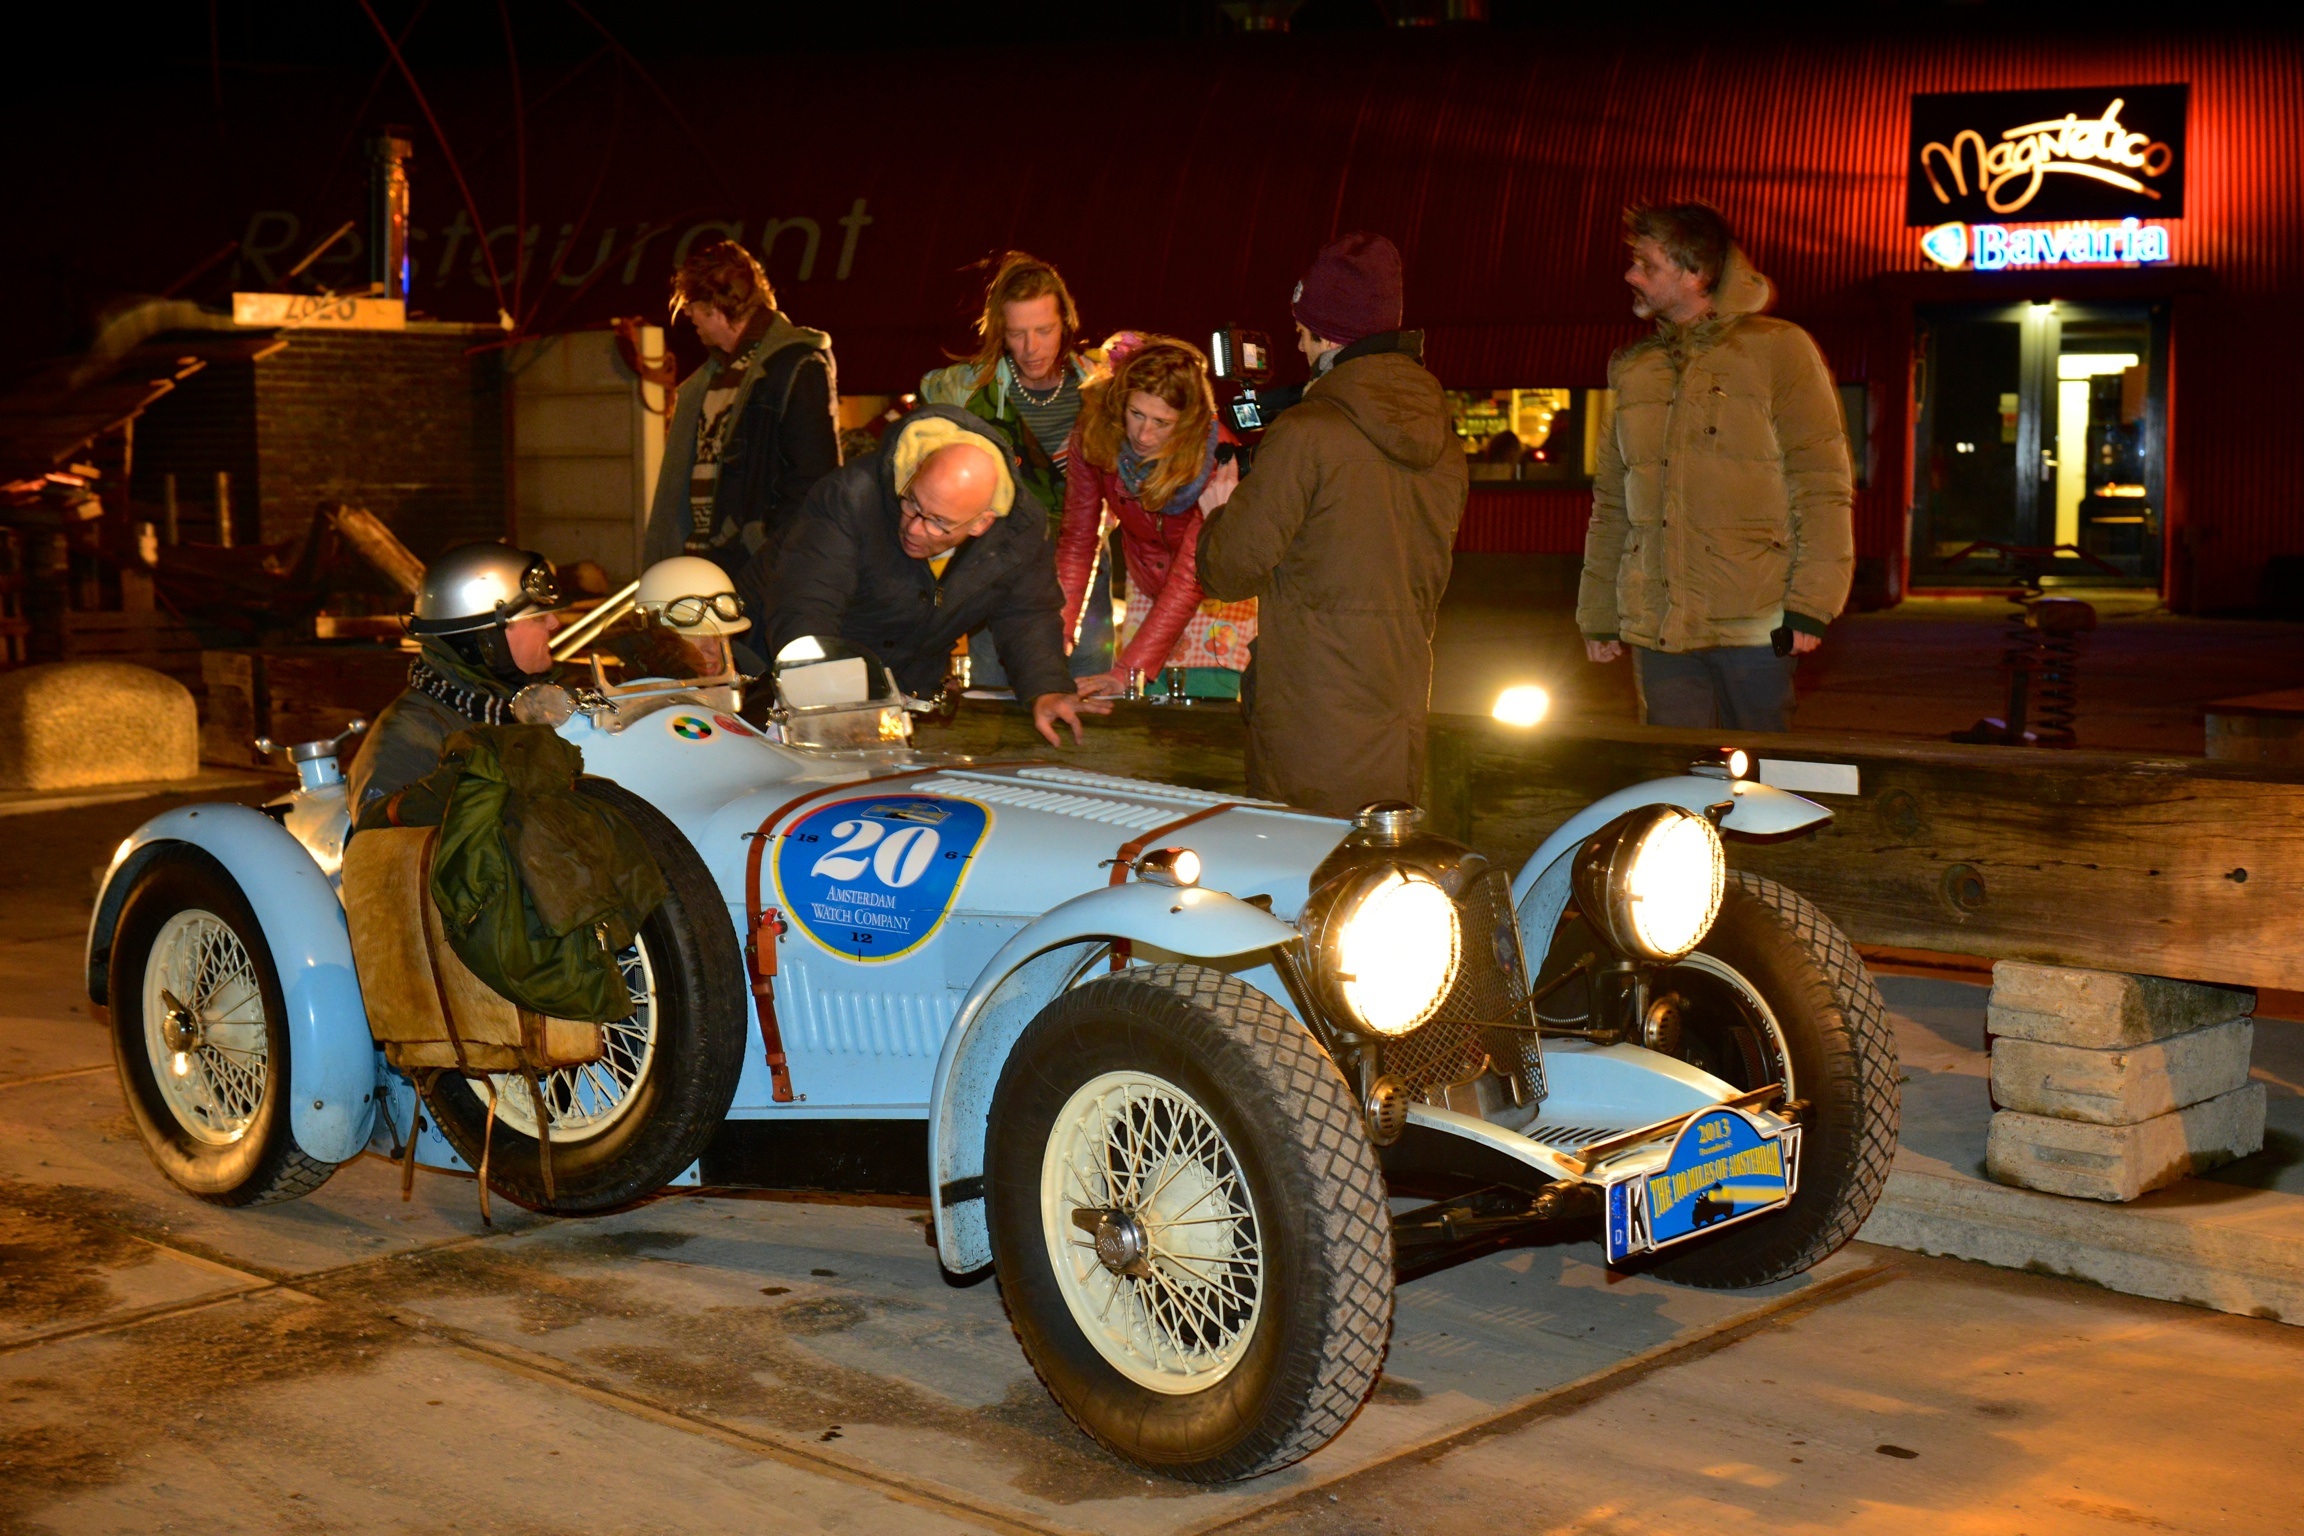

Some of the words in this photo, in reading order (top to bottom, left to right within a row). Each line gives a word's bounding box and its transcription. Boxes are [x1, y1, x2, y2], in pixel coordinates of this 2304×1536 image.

[233, 198, 873, 289] Restaurant
[1973, 217, 2169, 270] Bavaria
[797, 832, 819, 843] 18
[810, 820, 940, 888] 20
[944, 851, 958, 860] 6
[826, 885, 896, 909] AMSTERDAM
[811, 903, 852, 923] WATCH
[854, 908, 911, 930] COMPANY
[851, 931, 872, 944] 12
[1697, 1118, 1732, 1143] 2013
[1649, 1176, 1674, 1218] THE
[1672, 1171, 1689, 1203] 100
[1687, 1162, 1716, 1193] MILES
[1715, 1158, 1729, 1180] OF
[1729, 1141, 1783, 1178] AMSTERDAM
[1628, 1184, 1646, 1244] K
